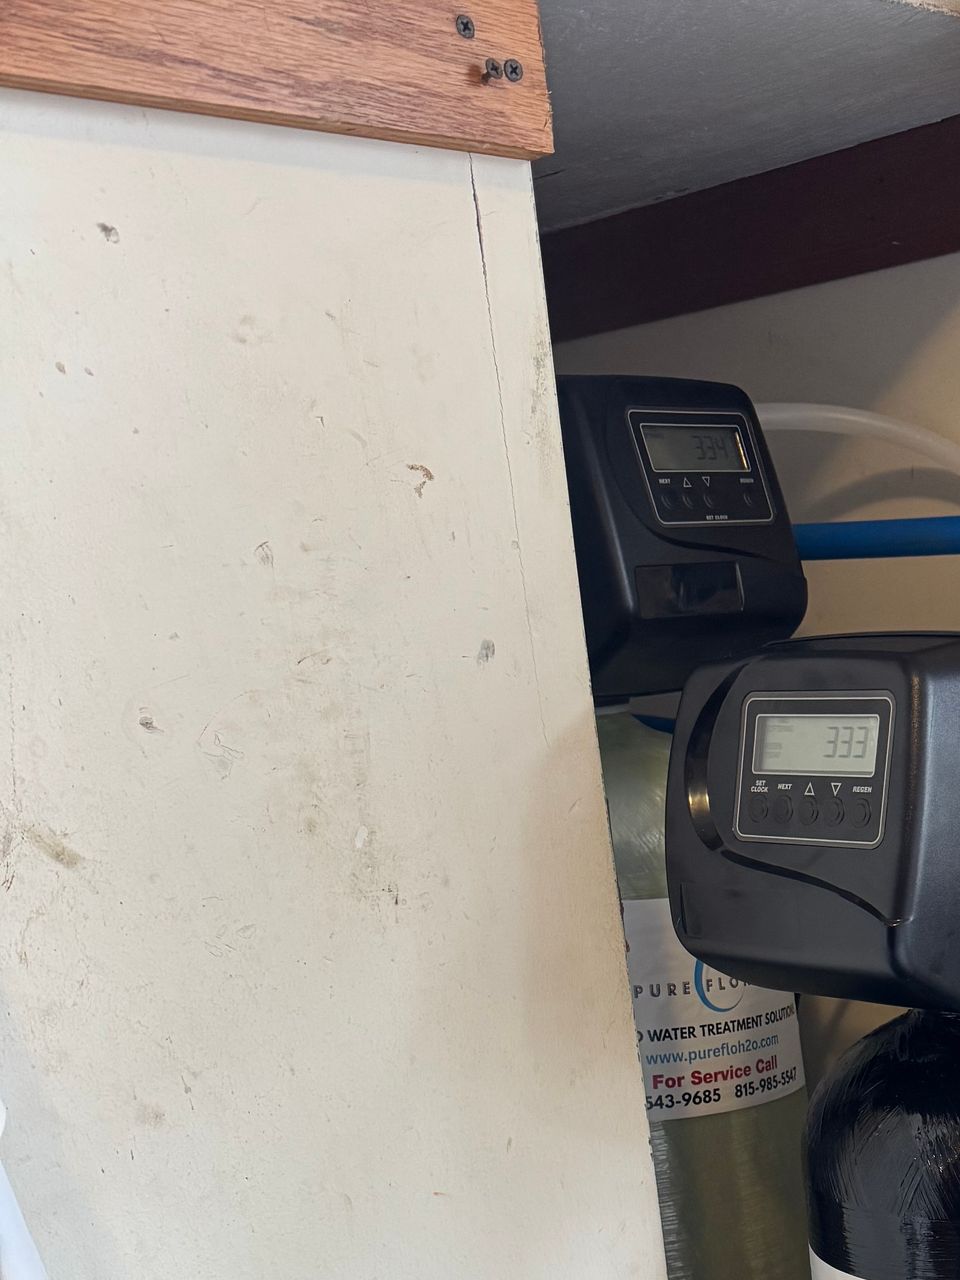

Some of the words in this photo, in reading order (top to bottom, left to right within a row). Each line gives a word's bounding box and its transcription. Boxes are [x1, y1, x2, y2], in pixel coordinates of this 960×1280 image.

[823, 726, 869, 758] 333
[633, 981, 691, 998] PURE
[647, 1026, 697, 1042] WATER
[699, 1014, 763, 1037] TREATMENT
[645, 1034, 779, 1065] www.purefloh2o.com
[652, 1073, 685, 1089] For
[690, 1065, 752, 1086] Service
[755, 1055, 778, 1074] Call
[734, 1066, 797, 1098] 815-985-5547
